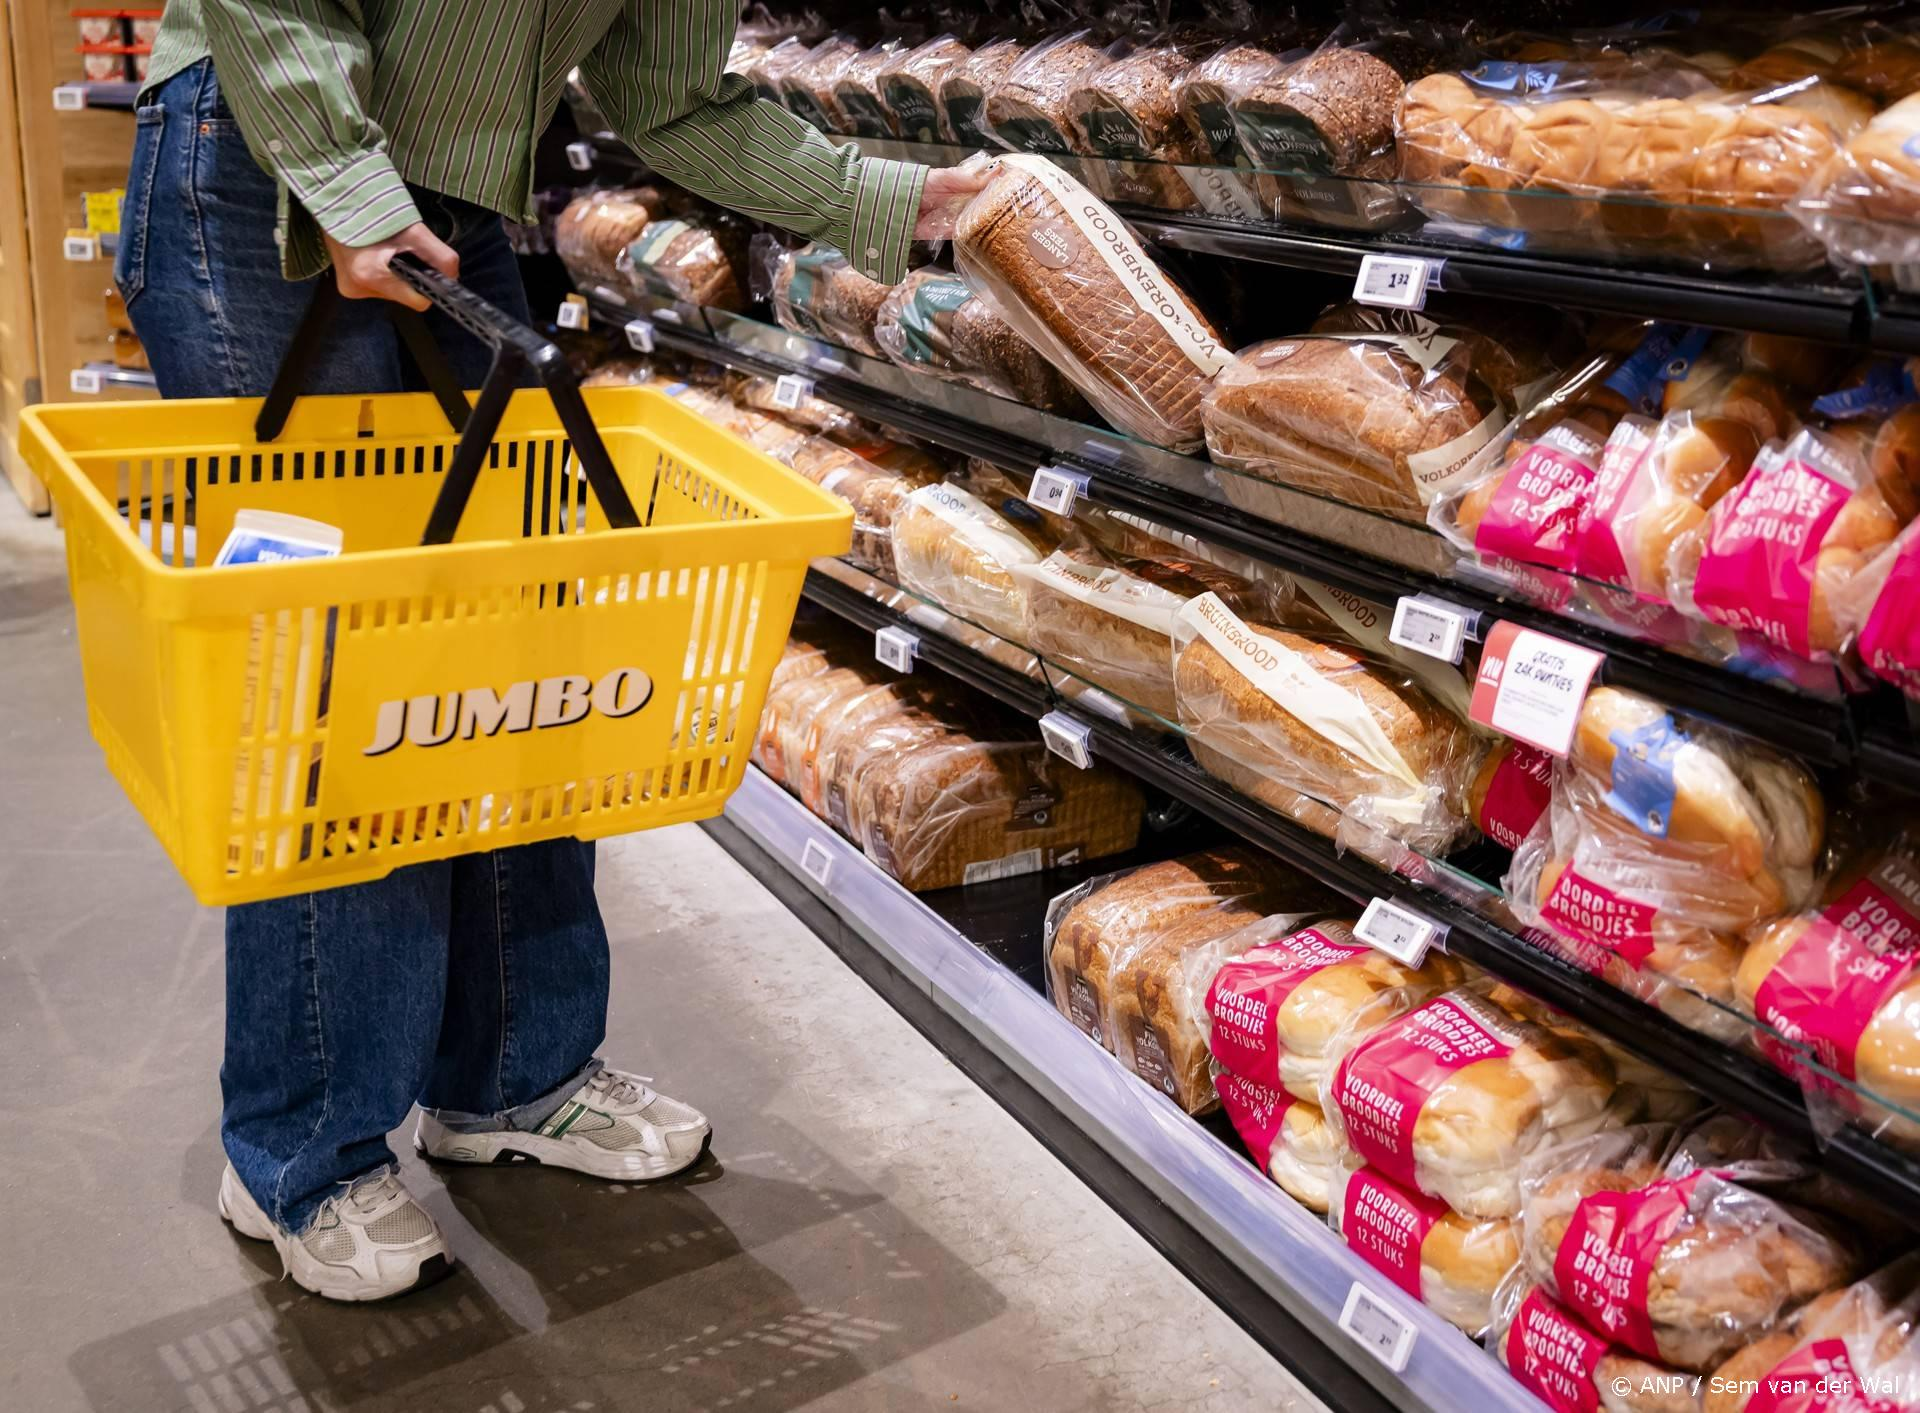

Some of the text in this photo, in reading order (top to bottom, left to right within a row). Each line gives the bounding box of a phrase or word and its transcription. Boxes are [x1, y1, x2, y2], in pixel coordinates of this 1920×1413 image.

[1031, 229, 1070, 263] LANGER
[1043, 228, 1070, 250] VERS
[1083, 205, 1216, 359] VOORENBROOD
[1323, 584, 1377, 629] BROOD
[1197, 596, 1279, 671] BRUINBROOD
[362, 666, 654, 757] JUMBO
[1214, 1003, 1265, 1035] BROODJES
[1216, 988, 1268, 1020] VOORDEEL
[1218, 1024, 1267, 1051] 12 STUKS
[1400, 1025, 1459, 1062] 12 STUKS
[1413, 1009, 1482, 1057] BROODJES
[1429, 1001, 1496, 1054] VOORDEEL
[1228, 1084, 1239, 1100] 12
[1242, 1096, 1267, 1130] STUKS
[1342, 1090, 1399, 1136] BROODJES
[1344, 1074, 1404, 1121] VOORDEEL
[1347, 1114, 1398, 1154] 12 STUKS
[1355, 1200, 1409, 1249] BROODJES
[1360, 1183, 1418, 1233] VOORDEEL
[1356, 1226, 1404, 1269] 12 STUKS
[1540, 1368, 1579, 1401] TUKS
